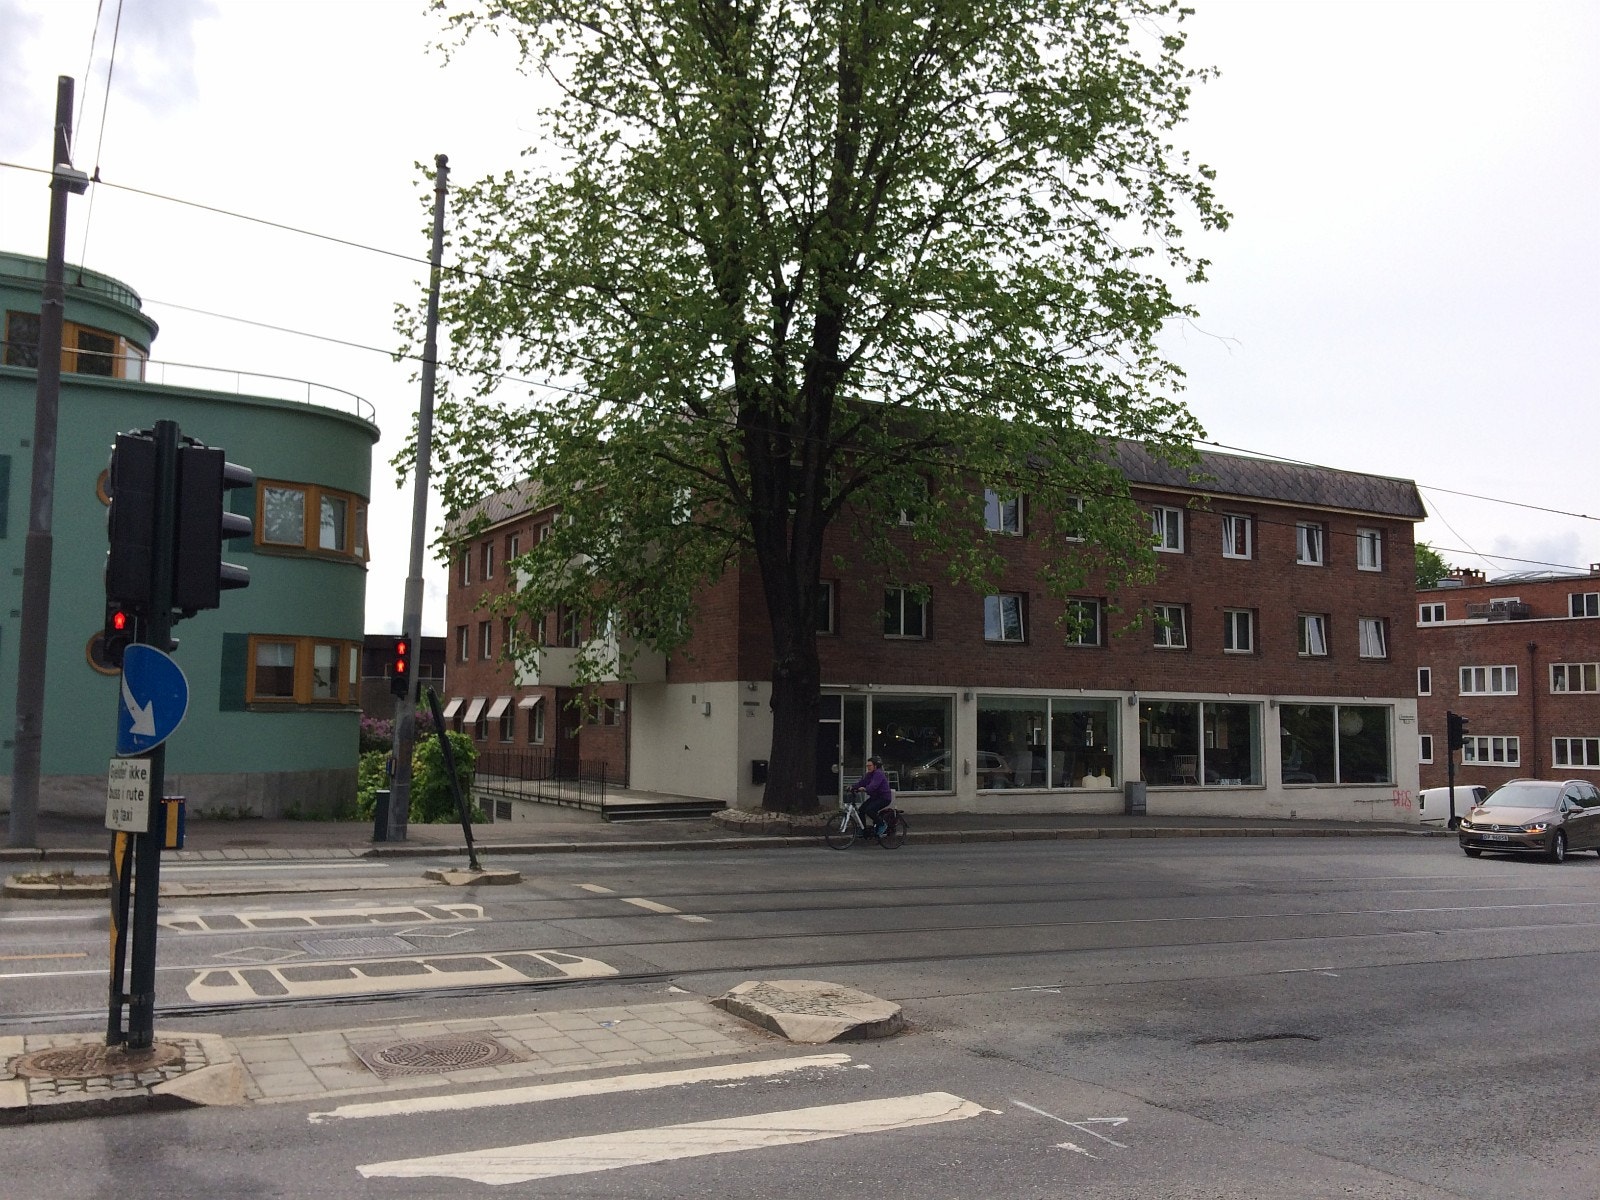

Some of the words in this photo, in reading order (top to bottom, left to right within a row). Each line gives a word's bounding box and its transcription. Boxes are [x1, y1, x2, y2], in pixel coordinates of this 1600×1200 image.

[129, 765, 147, 780] ikke
[109, 785, 121, 800] buss
[126, 787, 144, 801] rute
[120, 806, 133, 822] taxi
